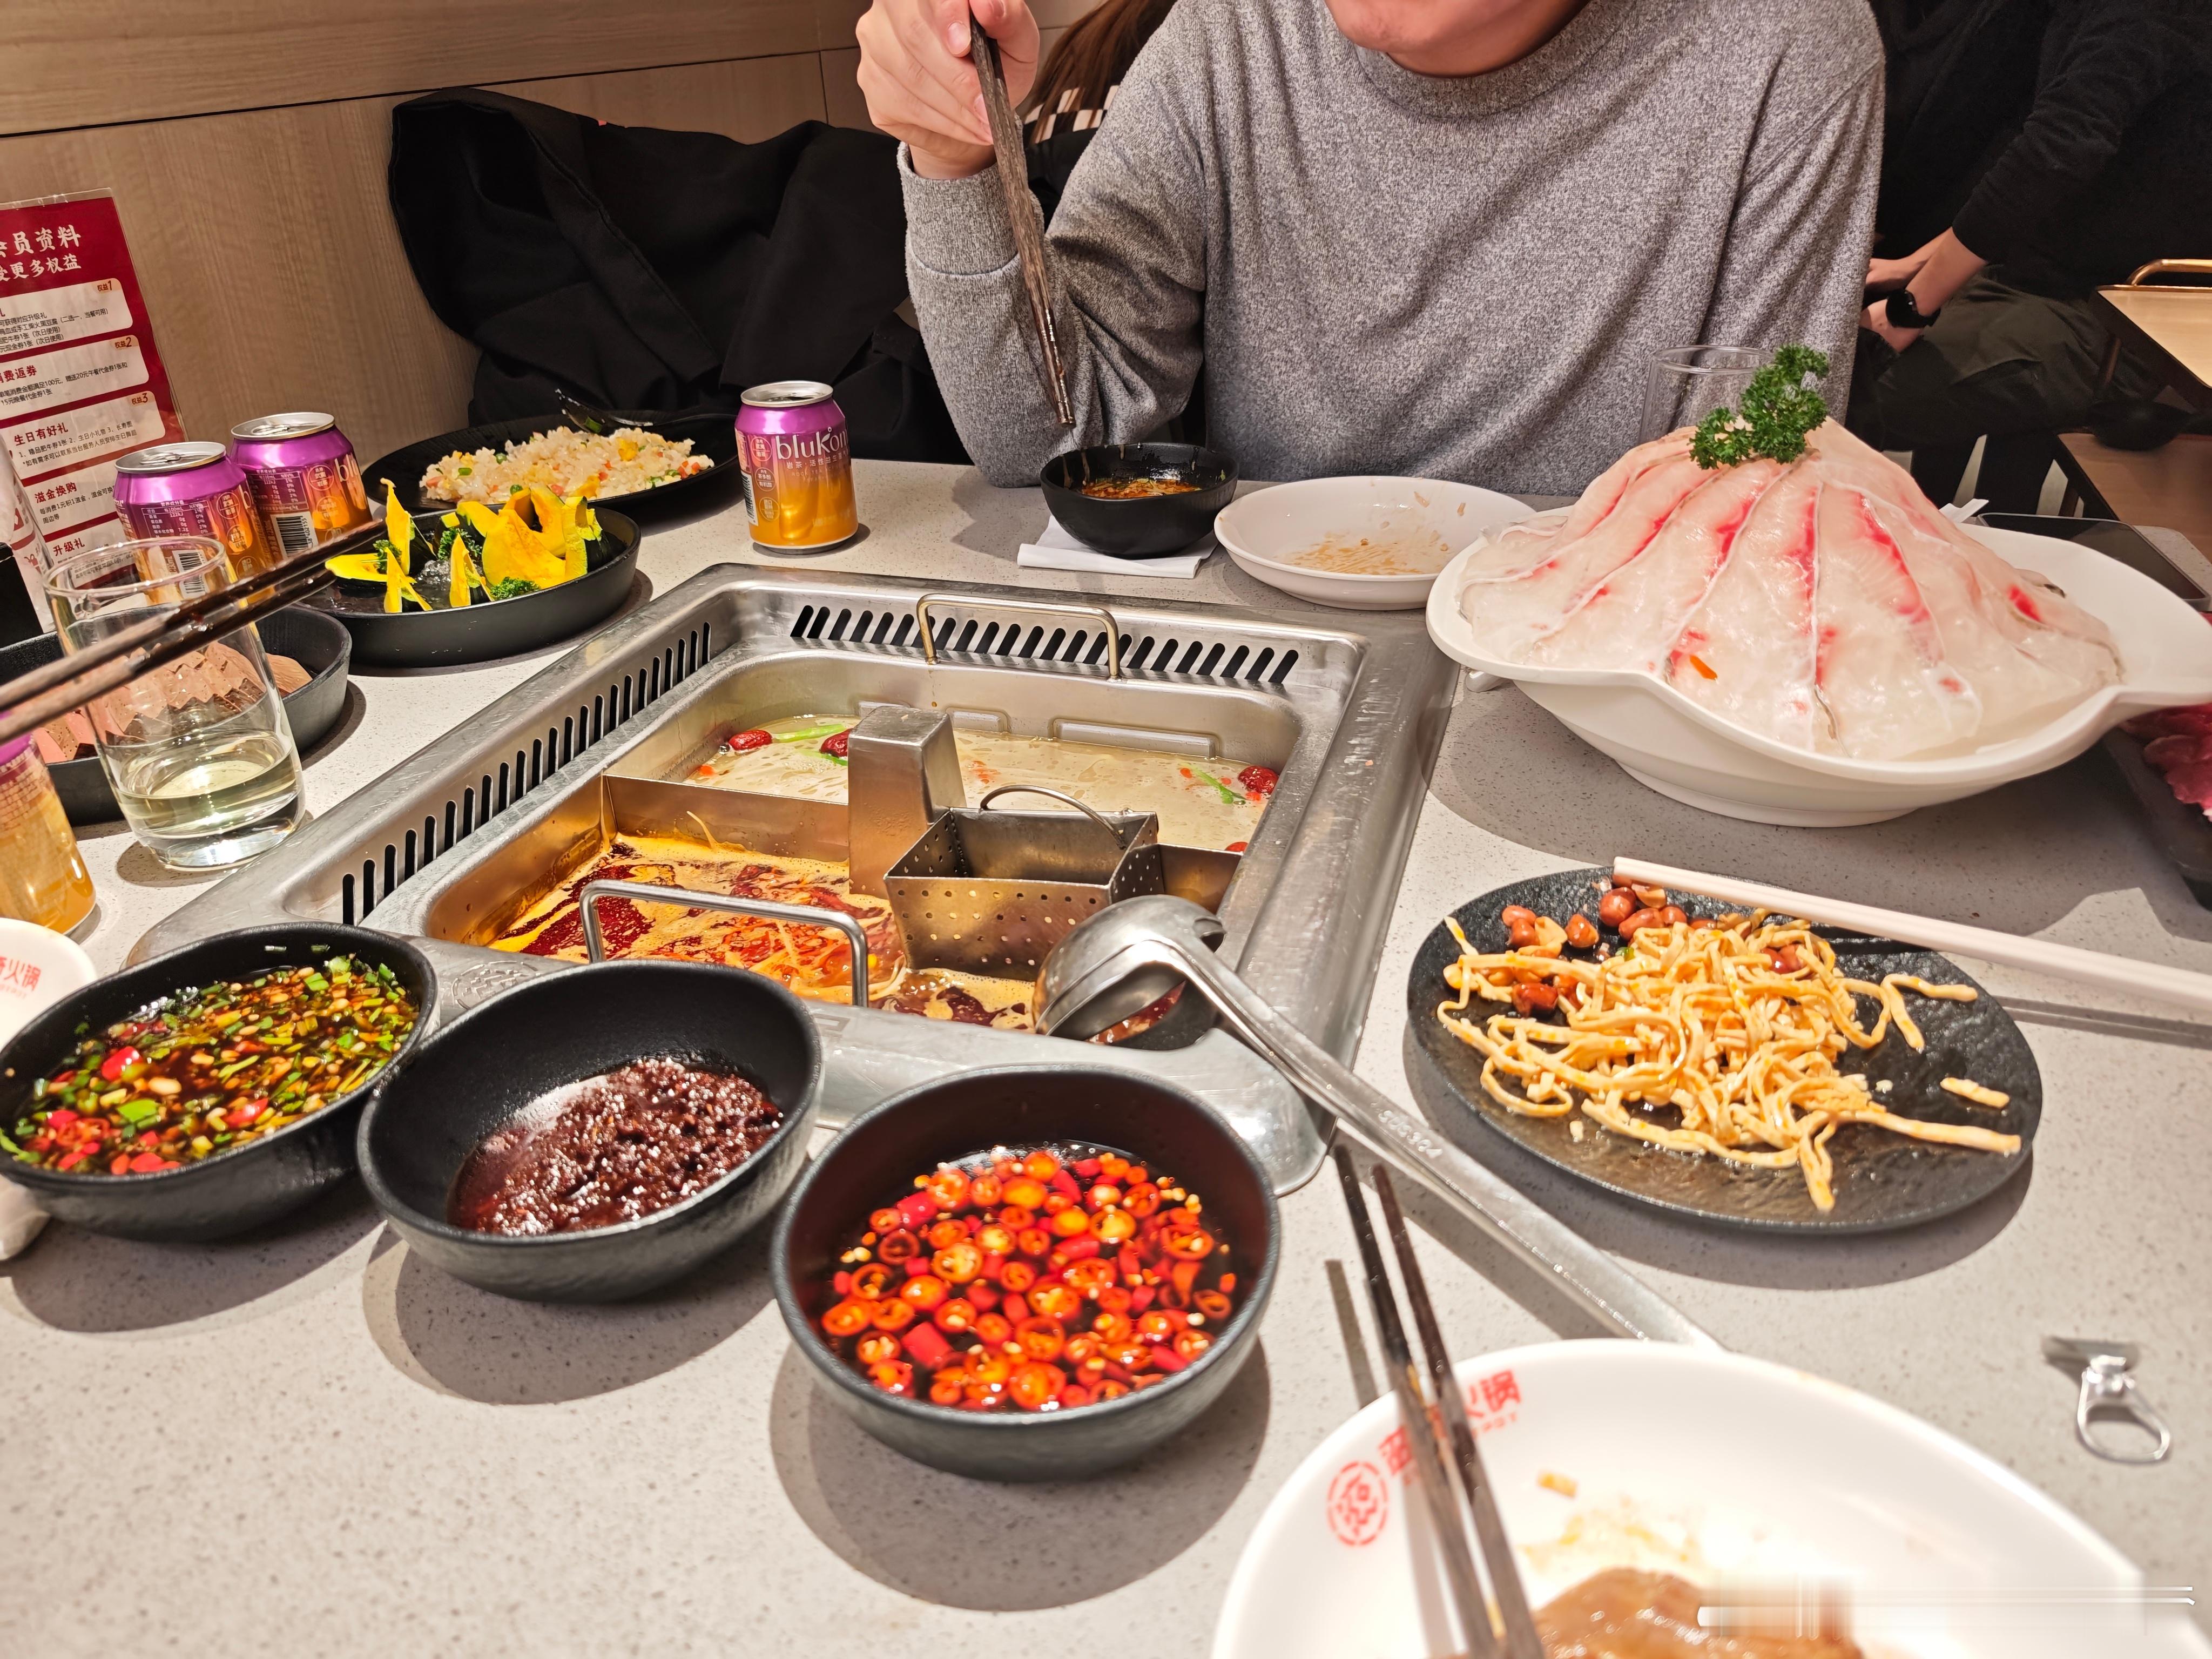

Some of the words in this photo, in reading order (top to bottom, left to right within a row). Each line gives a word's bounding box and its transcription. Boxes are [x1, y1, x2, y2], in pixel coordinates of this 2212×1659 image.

[97, 280, 112, 292] 权益1
[114, 337, 132, 349] 权益2
[14, 422, 69, 446] 生日有好礼
[35, 482, 77, 503] 滋金换购
[53, 538, 85, 556] 升级礼
[1378, 1110, 1444, 1158] SUS304
